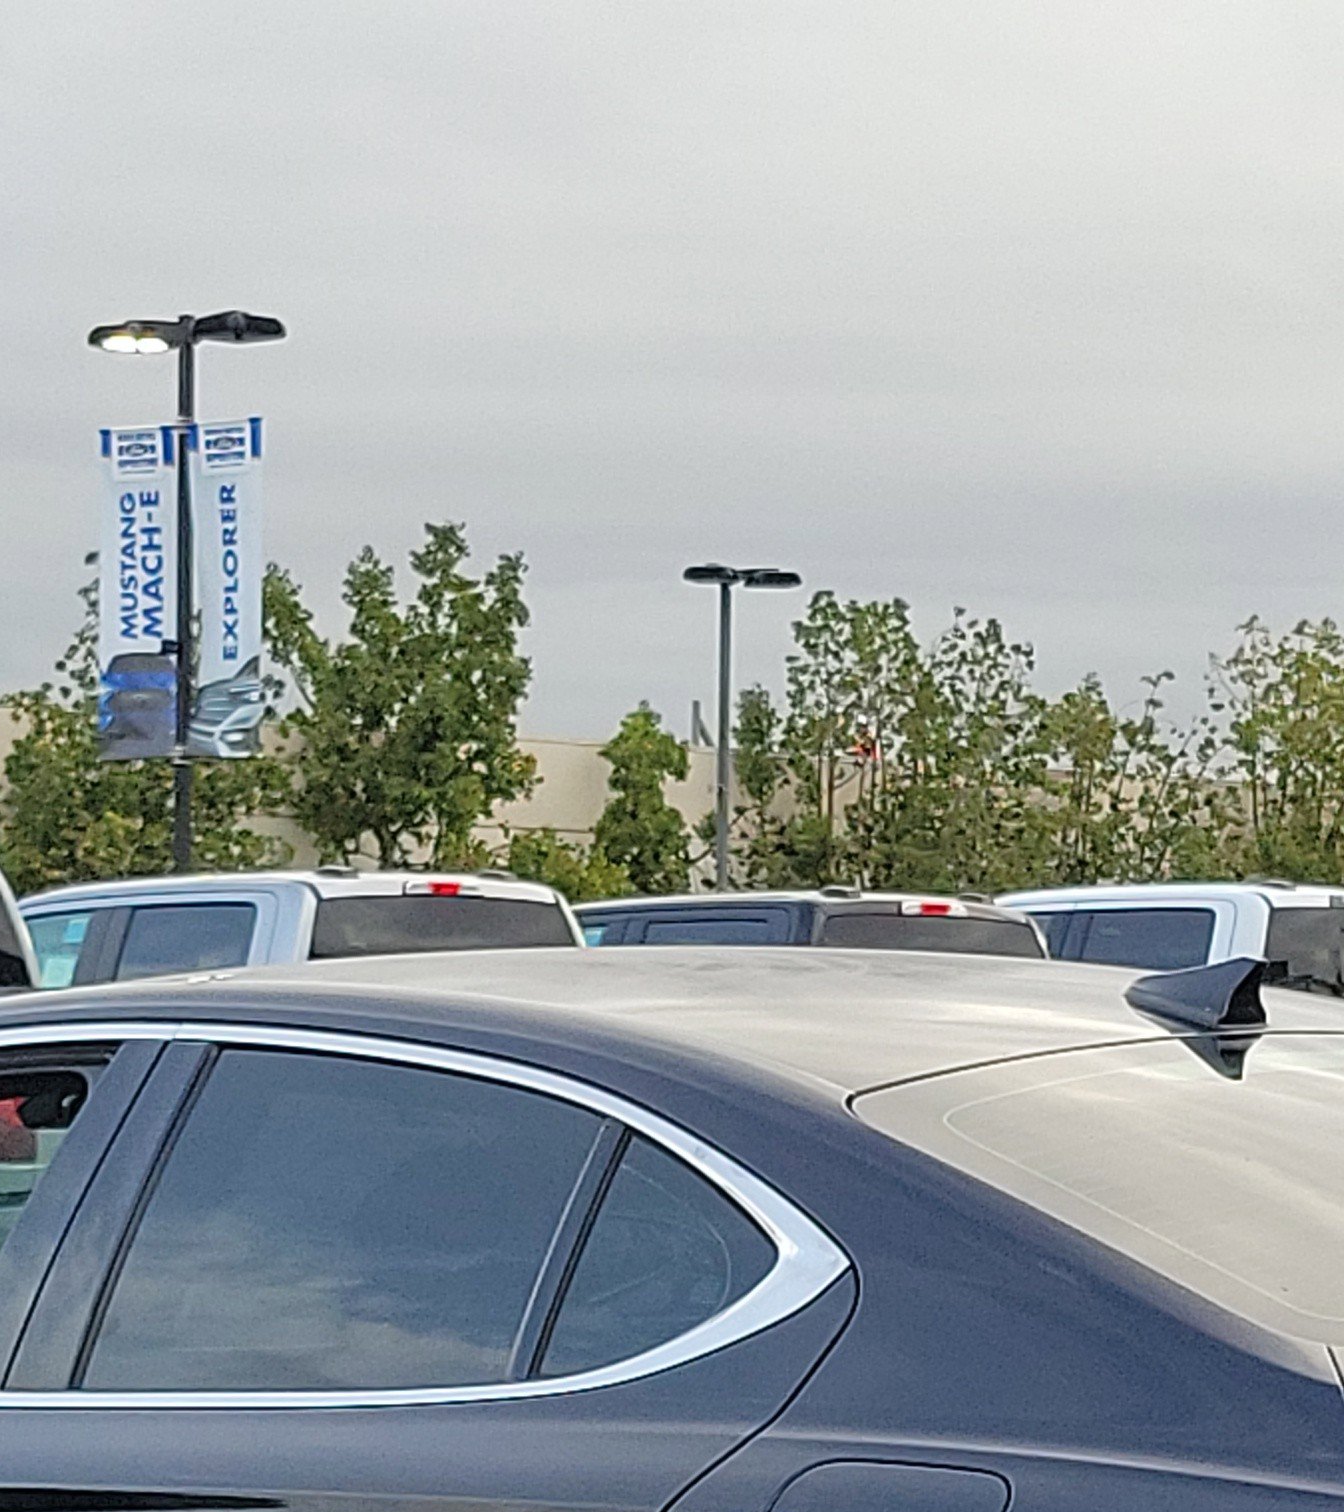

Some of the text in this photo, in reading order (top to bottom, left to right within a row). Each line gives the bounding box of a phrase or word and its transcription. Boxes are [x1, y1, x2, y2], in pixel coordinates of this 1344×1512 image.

[119, 492, 138, 640] MUSTANG
[139, 490, 164, 639] MACH-E
[218, 484, 238, 662] EXPLORER
